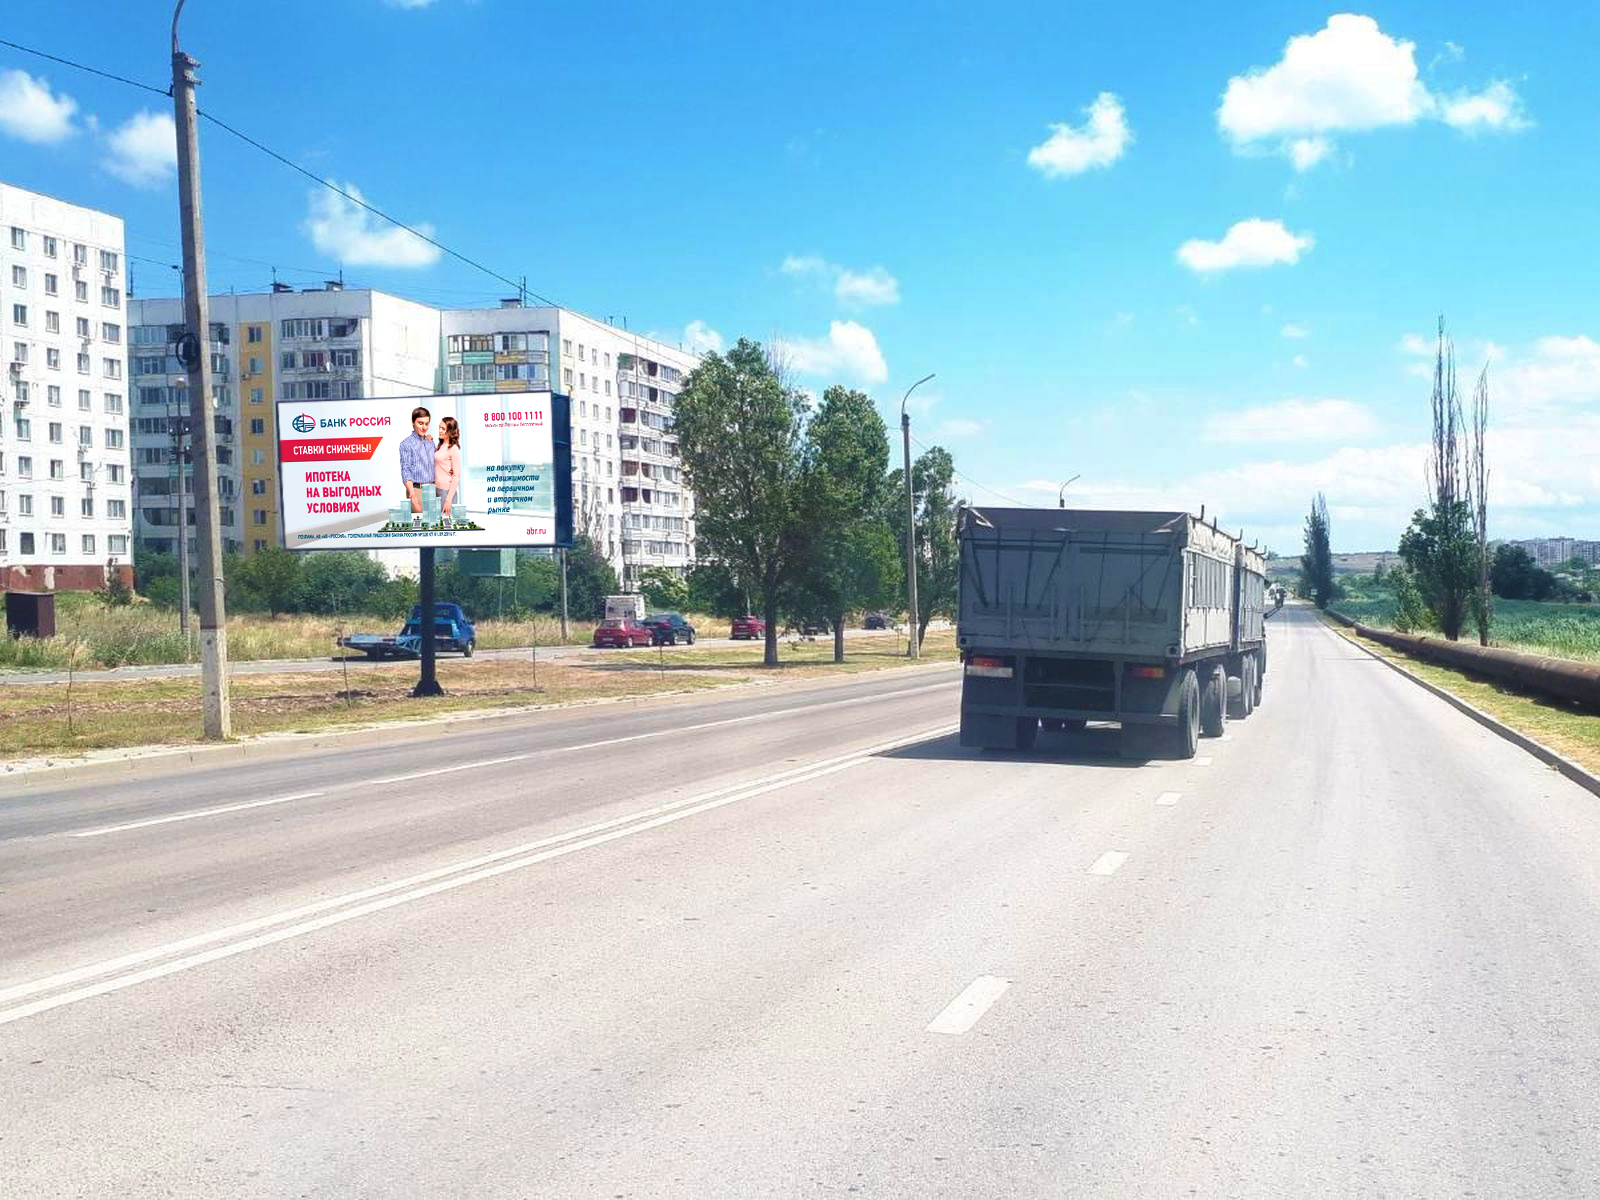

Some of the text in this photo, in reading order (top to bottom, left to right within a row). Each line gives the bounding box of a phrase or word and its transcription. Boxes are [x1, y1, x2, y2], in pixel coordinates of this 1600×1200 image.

[484, 411, 542, 421] 8 800 100 1111
[320, 416, 391, 428] БАНК РОССИЯ
[293, 444, 372, 455] СТАВКИ СНИЖЕНЫ!
[496, 464, 526, 472] покупку
[306, 471, 351, 482] ИПОТЕКА
[486, 474, 540, 482] недвижимости
[306, 486, 382, 499] НА ВЫГОДНЫХ
[307, 502, 360, 514] УСЛОВИЯХ
[526, 526, 547, 535] abr.ru
